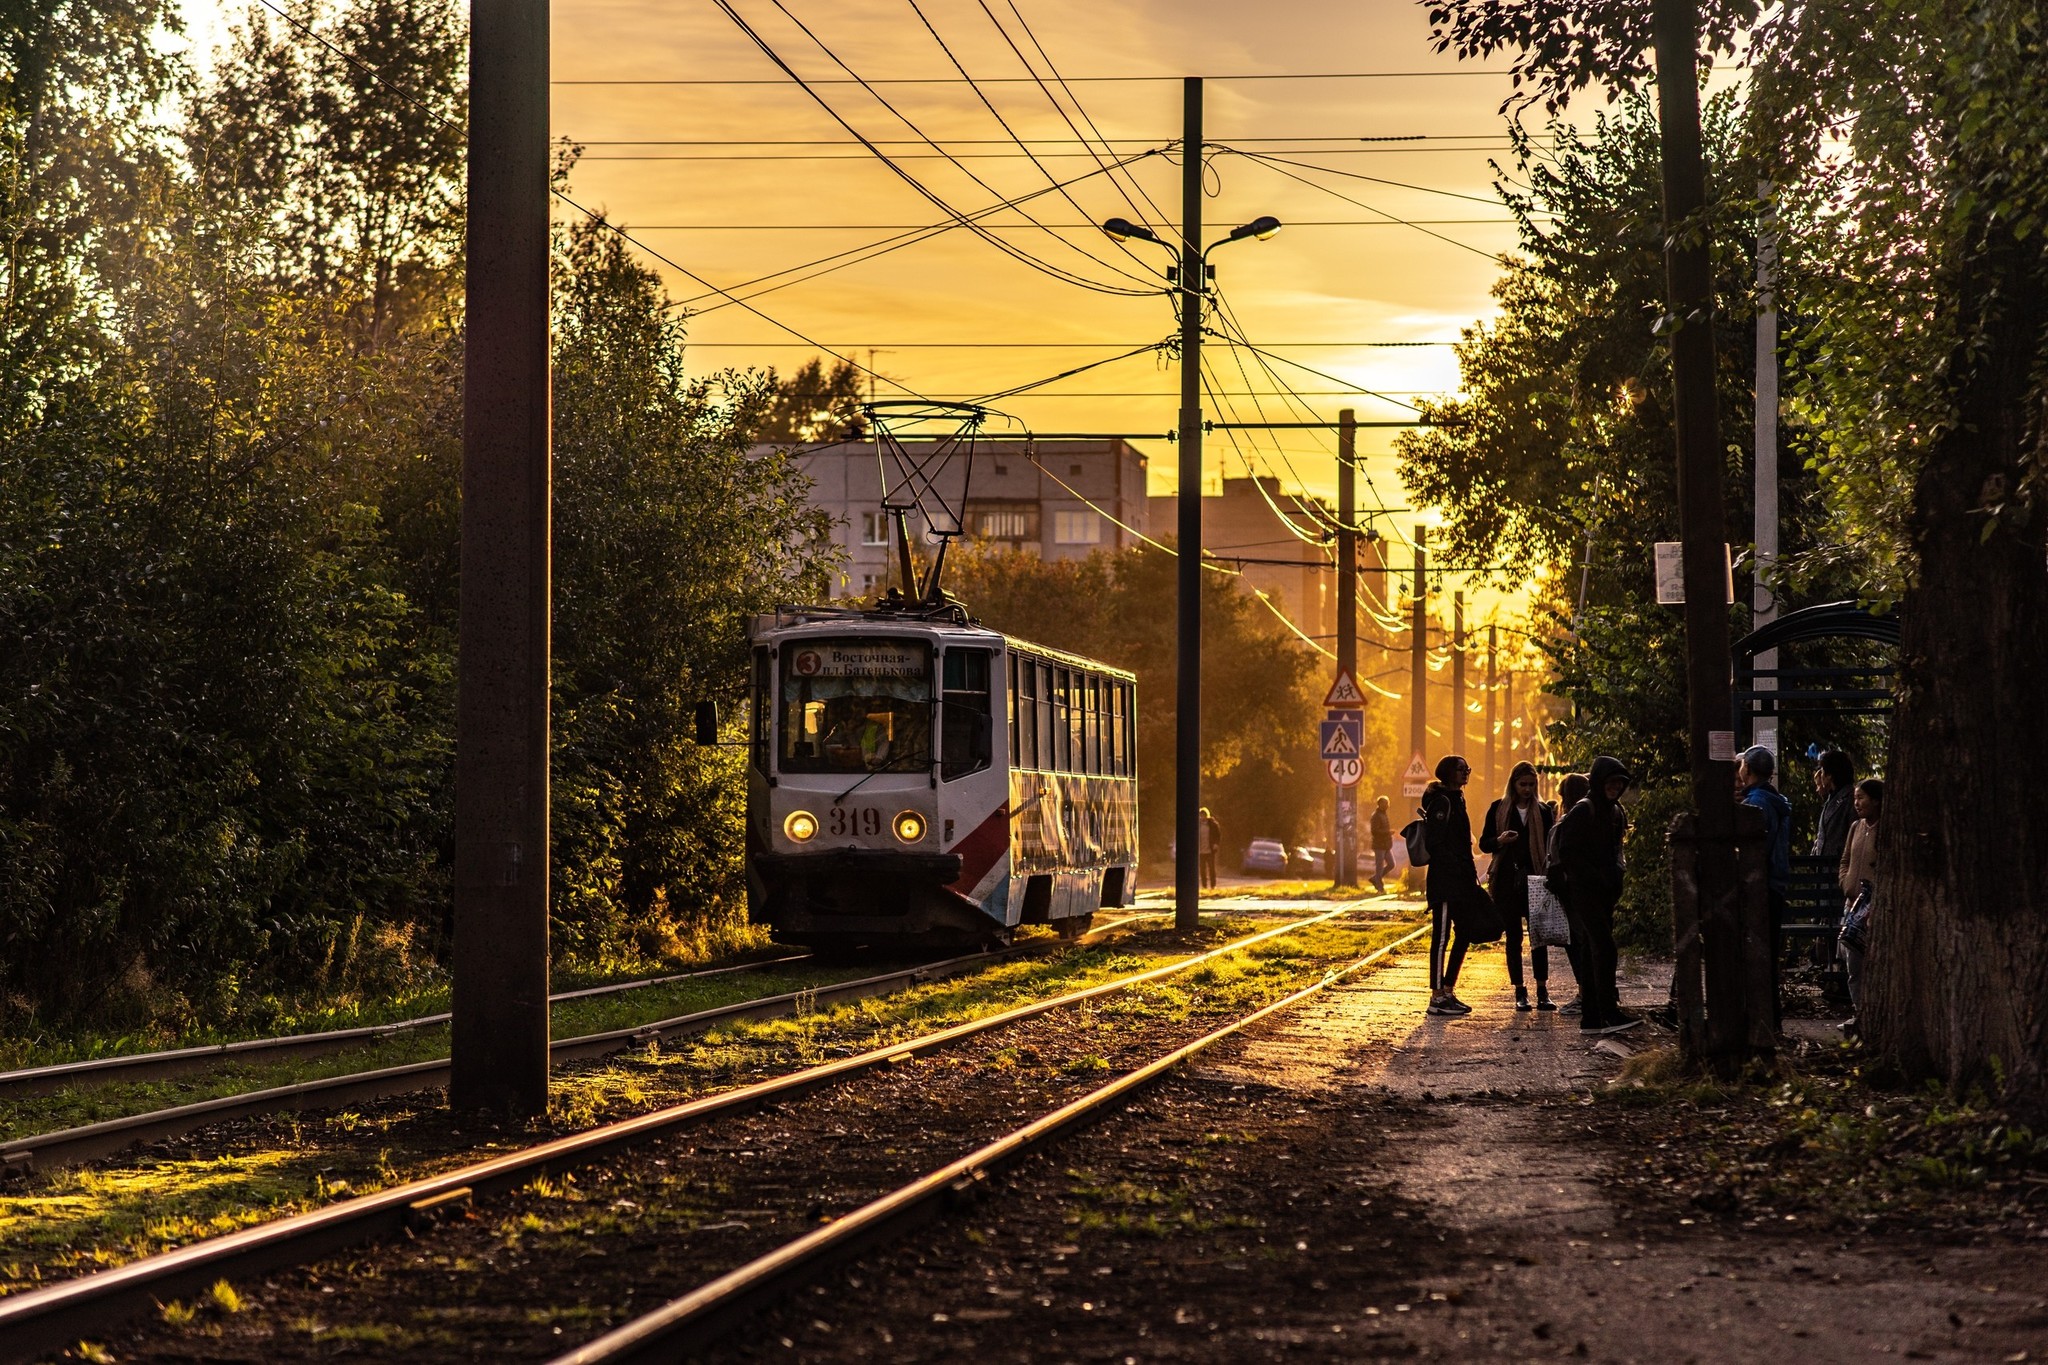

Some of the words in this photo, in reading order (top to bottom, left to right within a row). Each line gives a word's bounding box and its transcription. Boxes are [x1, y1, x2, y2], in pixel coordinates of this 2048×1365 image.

[801, 652, 816, 674] 3
[1333, 759, 1359, 776] 40
[829, 807, 881, 836] 319
